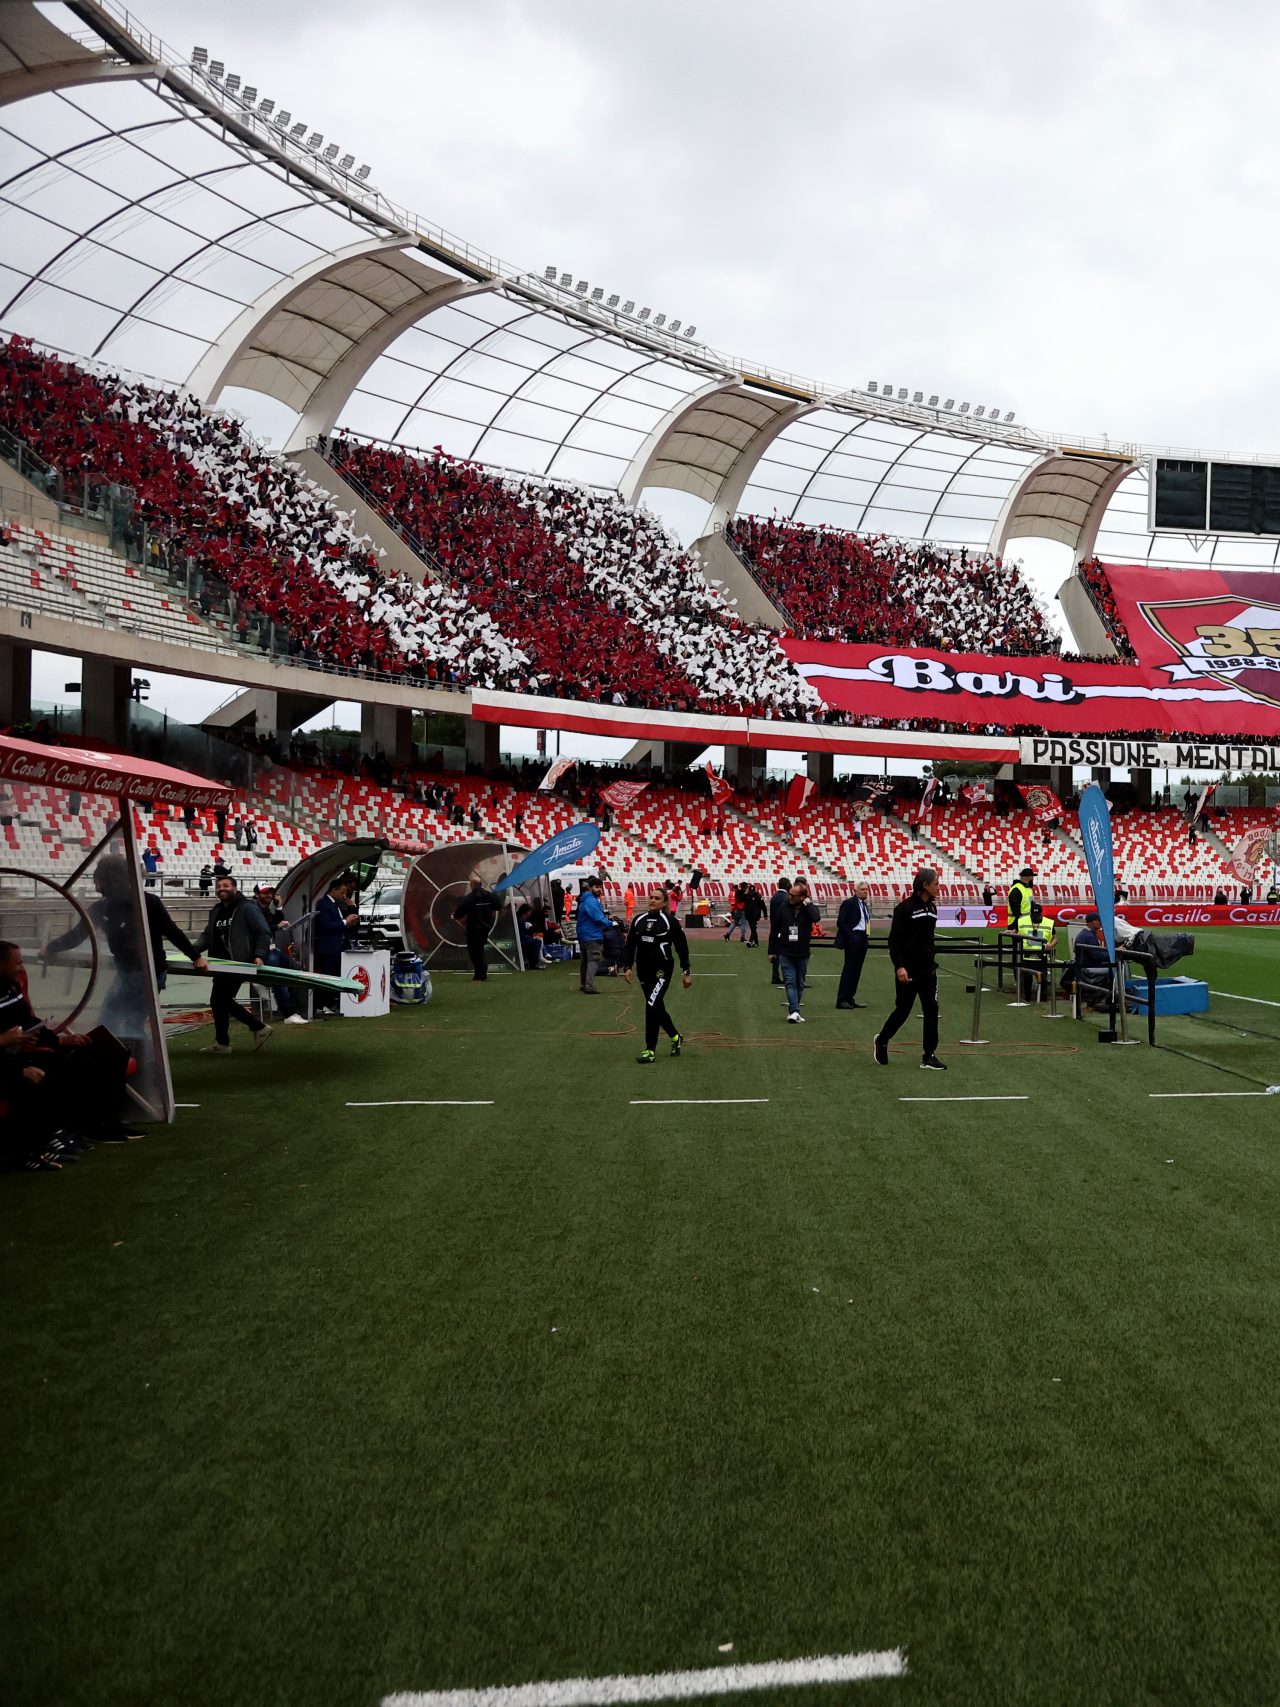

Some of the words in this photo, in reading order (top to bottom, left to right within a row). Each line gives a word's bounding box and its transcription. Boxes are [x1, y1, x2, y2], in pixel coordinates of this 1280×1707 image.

[868, 655, 1081, 703] Bari
[1033, 738, 1168, 768] PASSIONE,
[12, 755, 46, 778] Casillo
[54, 764, 87, 785] Casillo
[94, 772, 123, 792] Casillo
[129, 779, 154, 797] Casillo
[159, 785, 187, 802] Casillo
[543, 837, 583, 866] Amata
[1144, 907, 1212, 923] Casillo
[648, 978, 665, 1007] LEGEA
